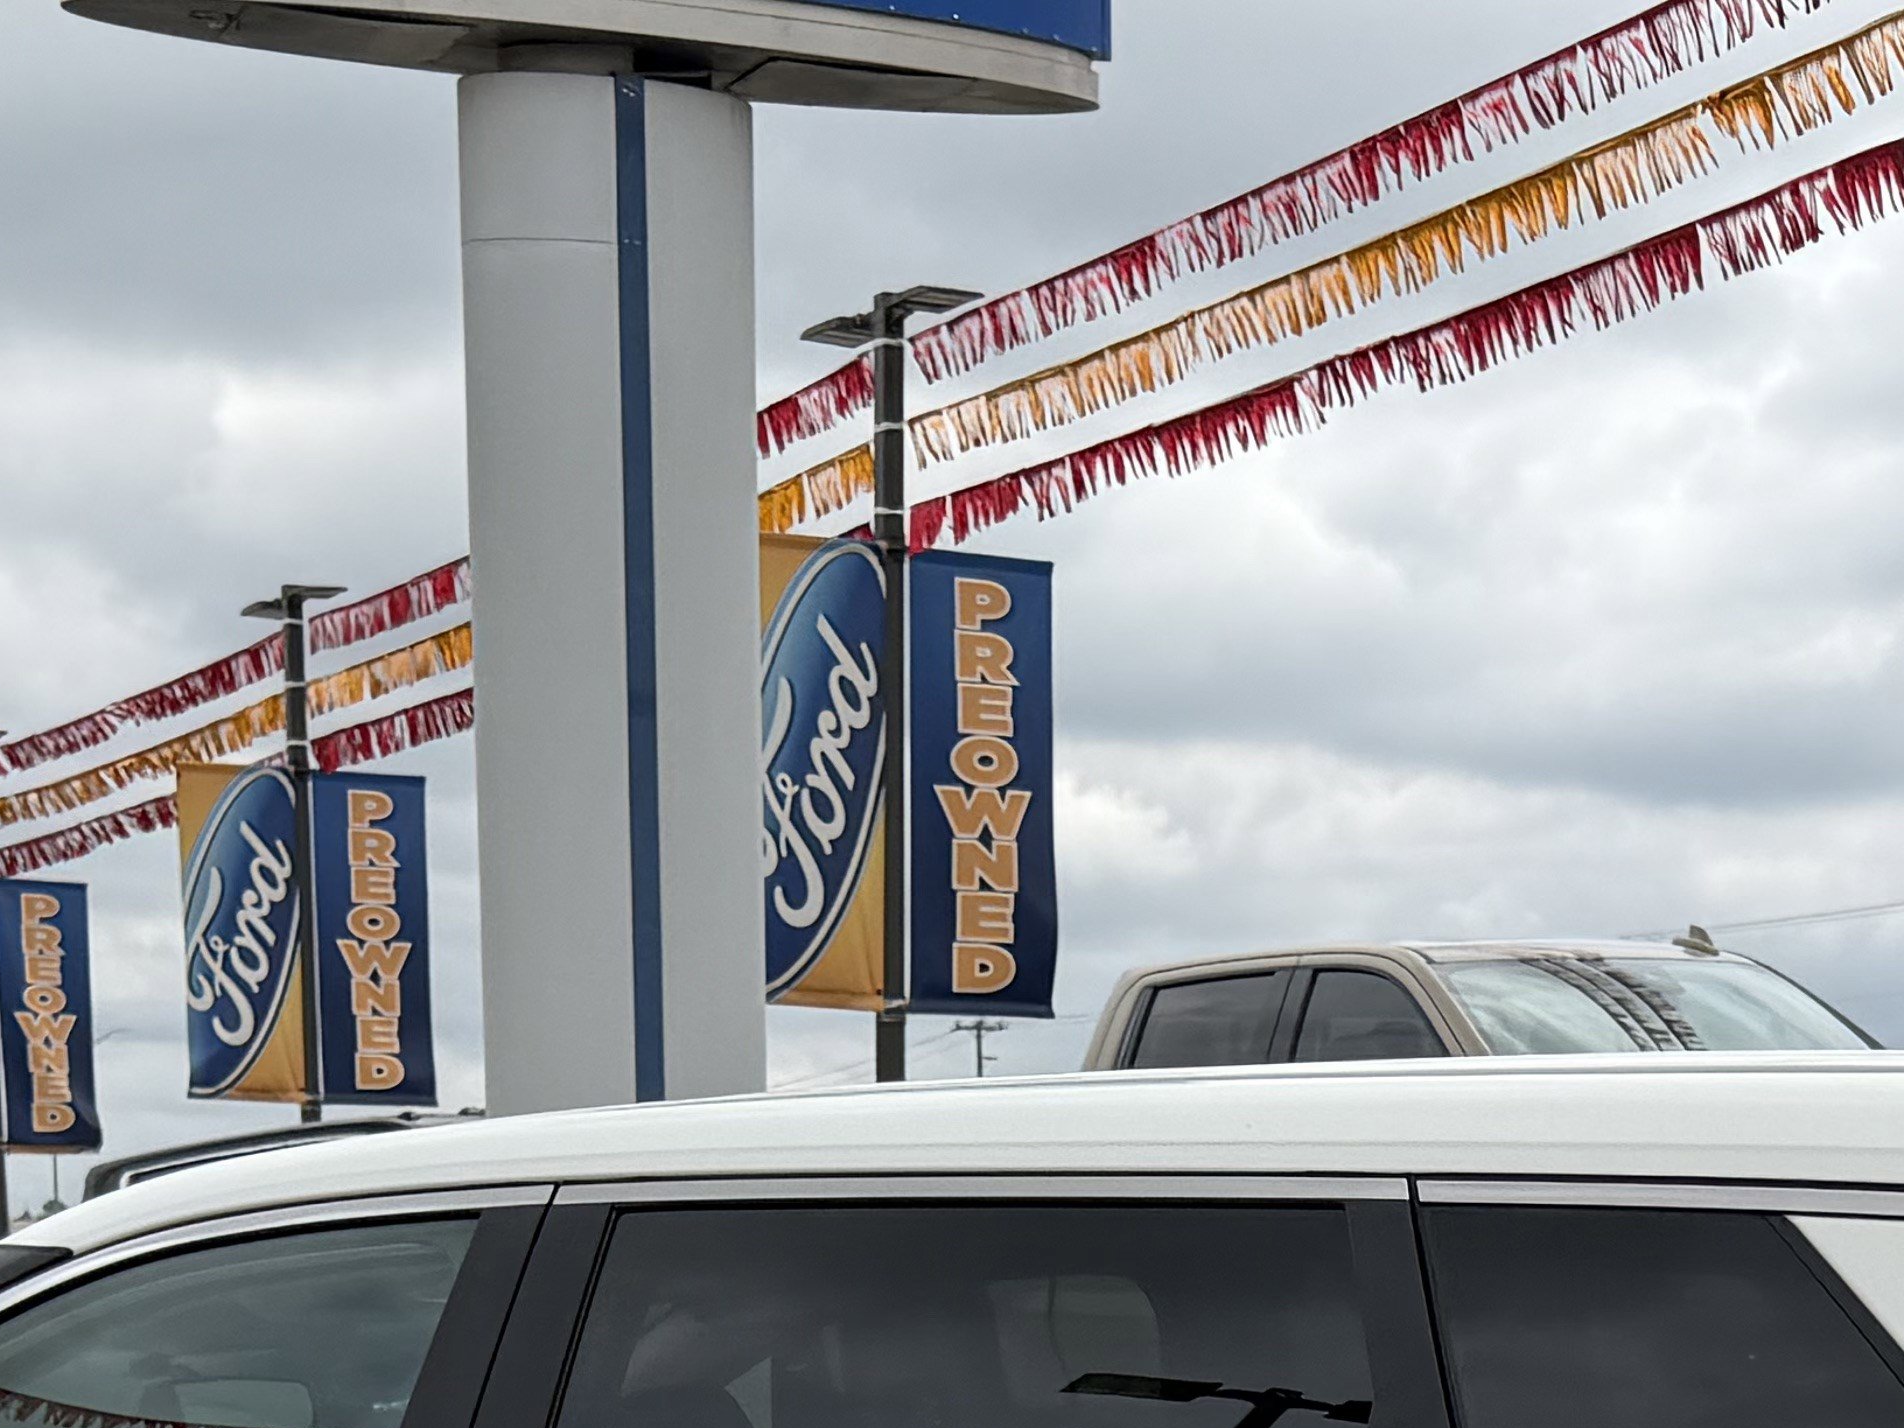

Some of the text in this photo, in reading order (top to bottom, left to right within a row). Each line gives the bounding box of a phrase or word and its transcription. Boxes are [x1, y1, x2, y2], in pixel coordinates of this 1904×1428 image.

[759, 613, 879, 929] Ford
[934, 577, 1032, 994] PREOWNED
[16, 893, 77, 1133] PREOWNED
[187, 820, 292, 1047] Ford
[336, 789, 412, 1092] PREOWNED
